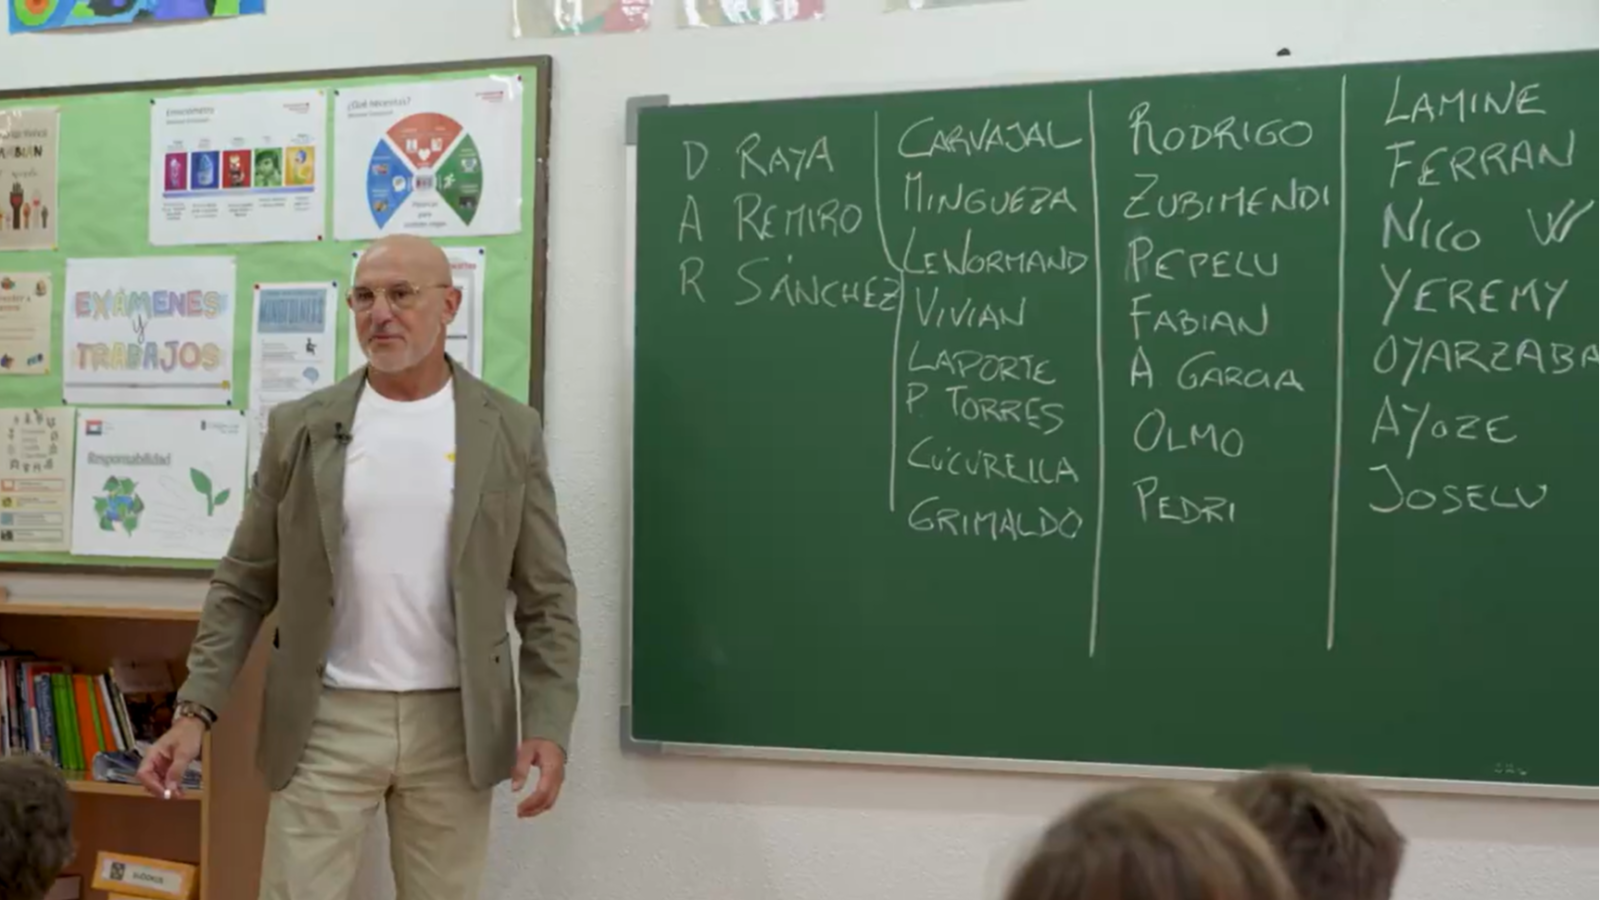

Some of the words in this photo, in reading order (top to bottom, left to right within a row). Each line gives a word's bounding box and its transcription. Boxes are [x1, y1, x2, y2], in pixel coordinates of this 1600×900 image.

[1384, 74, 1547, 126] LAMINE
[897, 116, 1083, 158] CARVAJAL
[1128, 100, 1314, 156] RODRIGO
[682, 139, 709, 181] D
[735, 131, 834, 182] RAYA
[1385, 128, 1575, 189] FERRAN
[678, 193, 703, 244] A
[732, 191, 863, 242] REMIRO
[904, 171, 1078, 215] MINGUEZA
[1123, 172, 1330, 222] ZUBIMENDI
[1382, 196, 1481, 253] NICO
[1526, 198, 1595, 247] W
[902, 226, 1089, 276] LENORMAND
[1127, 235, 1279, 283] PEPELU
[74, 286, 222, 321] EXÁMENES
[679, 255, 706, 303] R
[734, 253, 902, 312] SÁNCHEZ
[1380, 262, 1569, 327] YEREMY
[131, 313, 150, 346] y
[915, 285, 1026, 331] VIVIAN
[1129, 292, 1269, 341] FABIAN
[76, 340, 221, 374] TRABAJOS
[908, 340, 1056, 385] LAPORTE
[1130, 345, 1153, 390] A
[1177, 350, 1306, 392] GARCIA
[1373, 333, 1600, 388] OYARZABA
[905, 381, 929, 414] P
[944, 385, 1065, 436] TORRES
[1133, 407, 1244, 458] OLMO
[1371, 394, 1518, 460] AYOZE
[87, 450, 172, 468] Responsabilidad
[1131, 475, 1236, 524] PEDRI
[1368, 463, 1548, 515] JOSELU
[907, 495, 1084, 542] GRIMALDO
